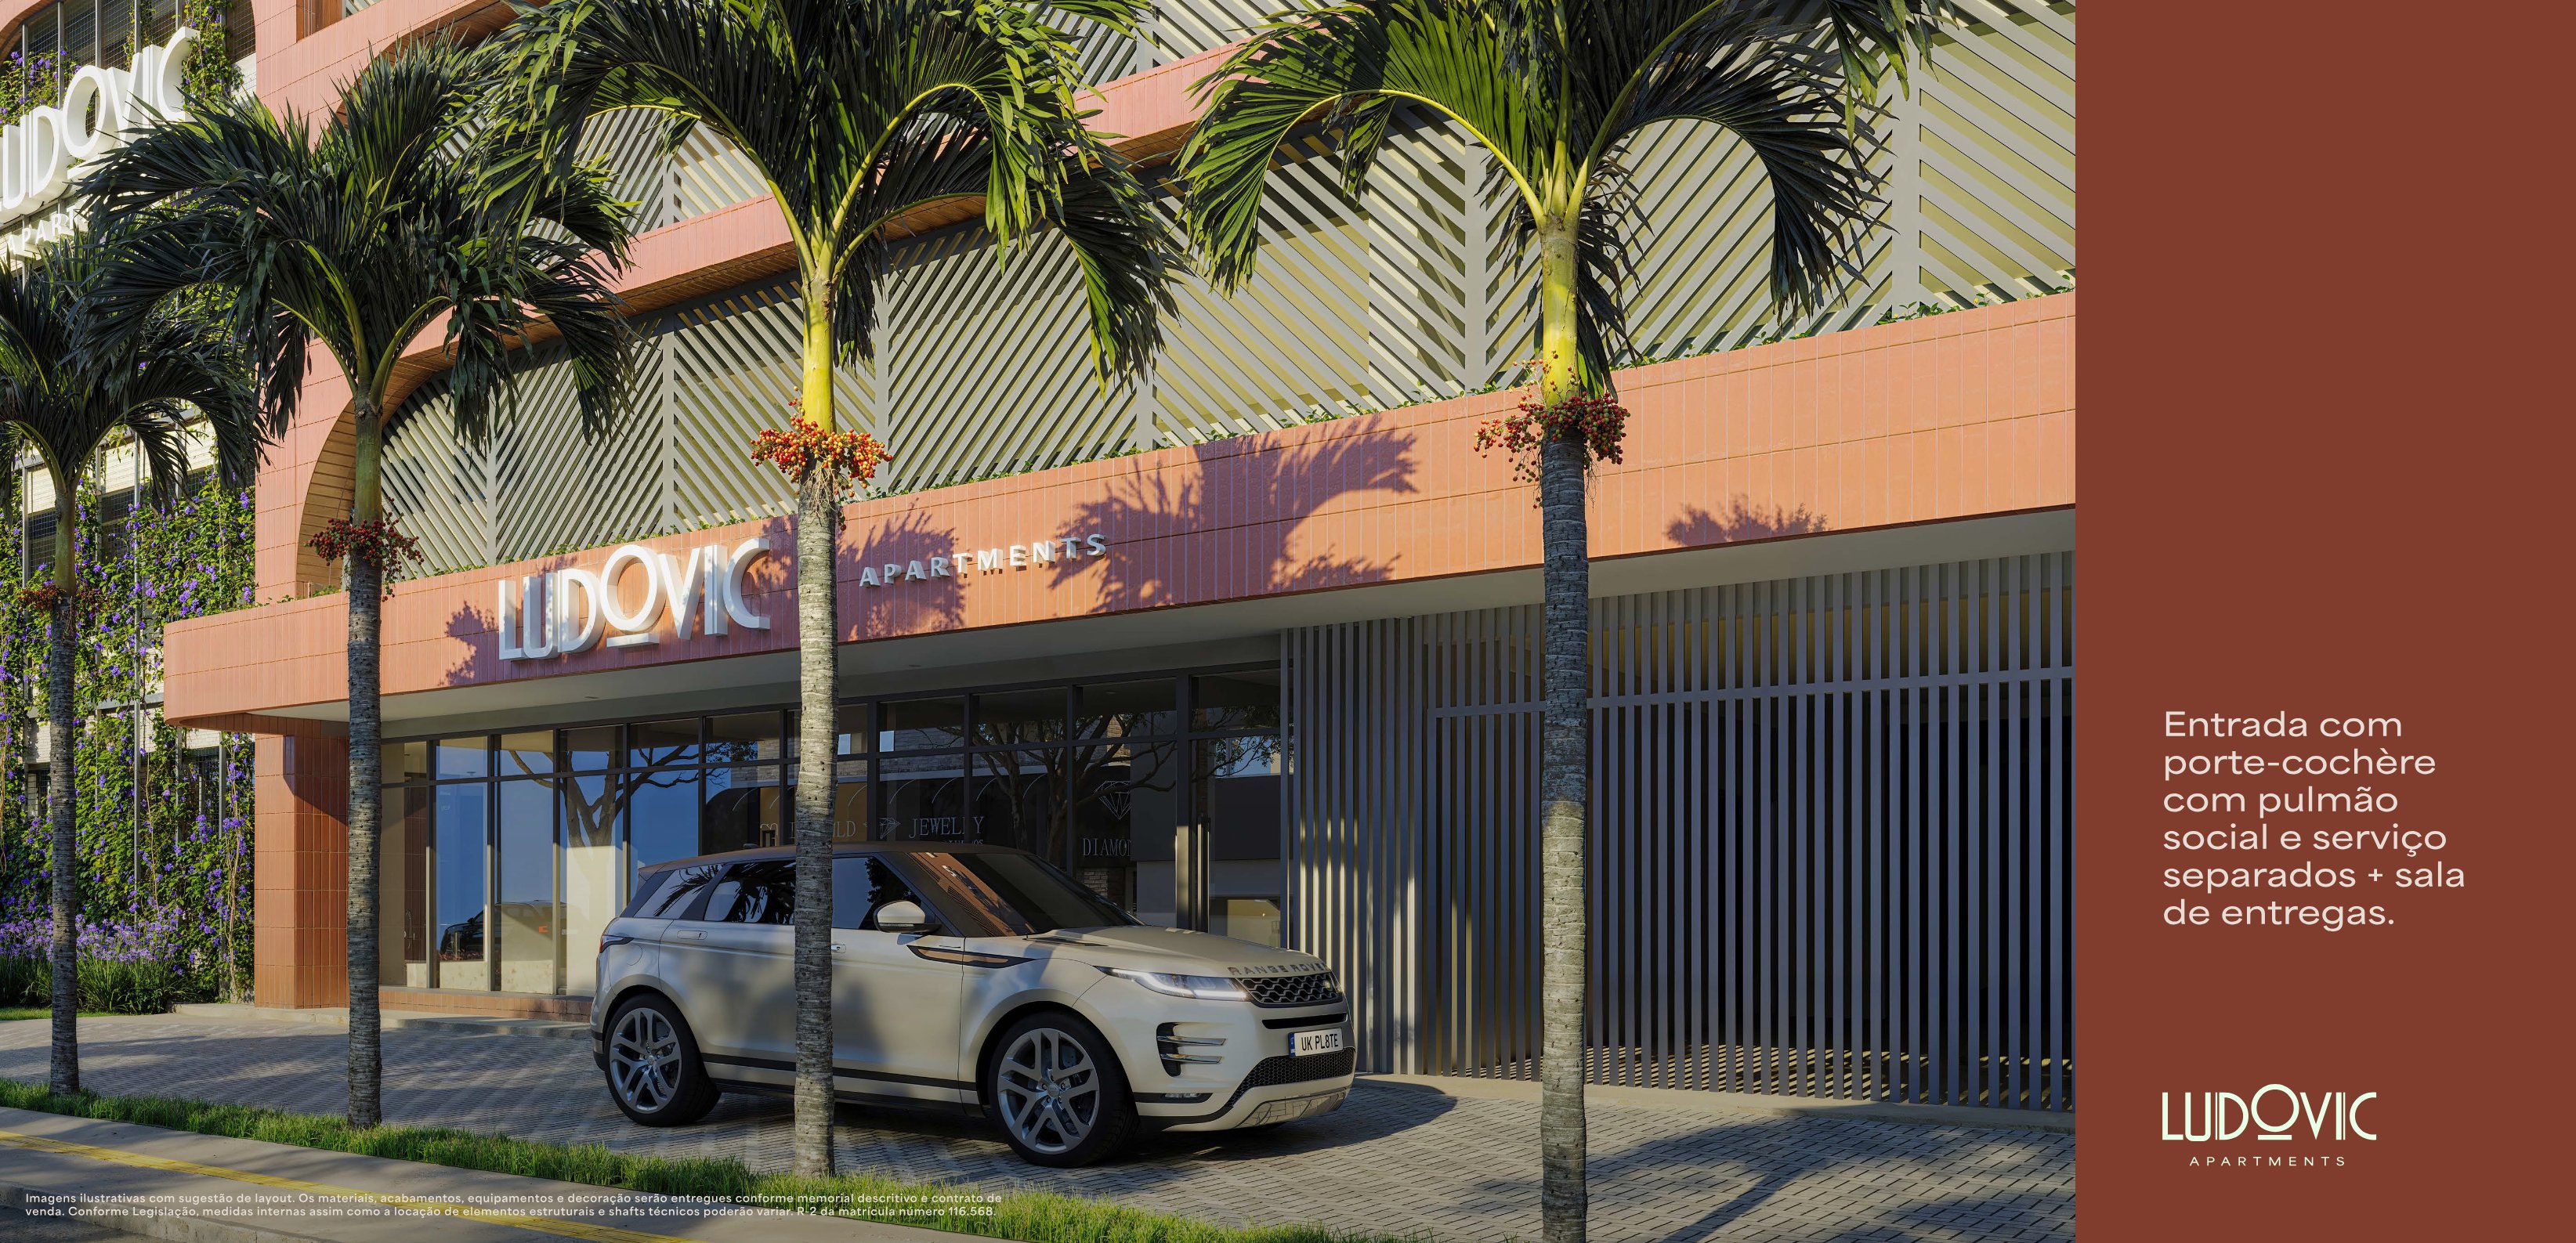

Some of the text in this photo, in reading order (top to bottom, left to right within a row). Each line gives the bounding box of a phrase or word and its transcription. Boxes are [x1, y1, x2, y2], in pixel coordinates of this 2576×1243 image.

[0, 27, 201, 219] UDOVIC
[859, 533, 1106, 587] APARTMENTS
[498, 537, 770, 660] LUDOVIC
[1228, 965, 1289, 975] RANGE
[1301, 1034, 1338, 1051] UK PL8TE
